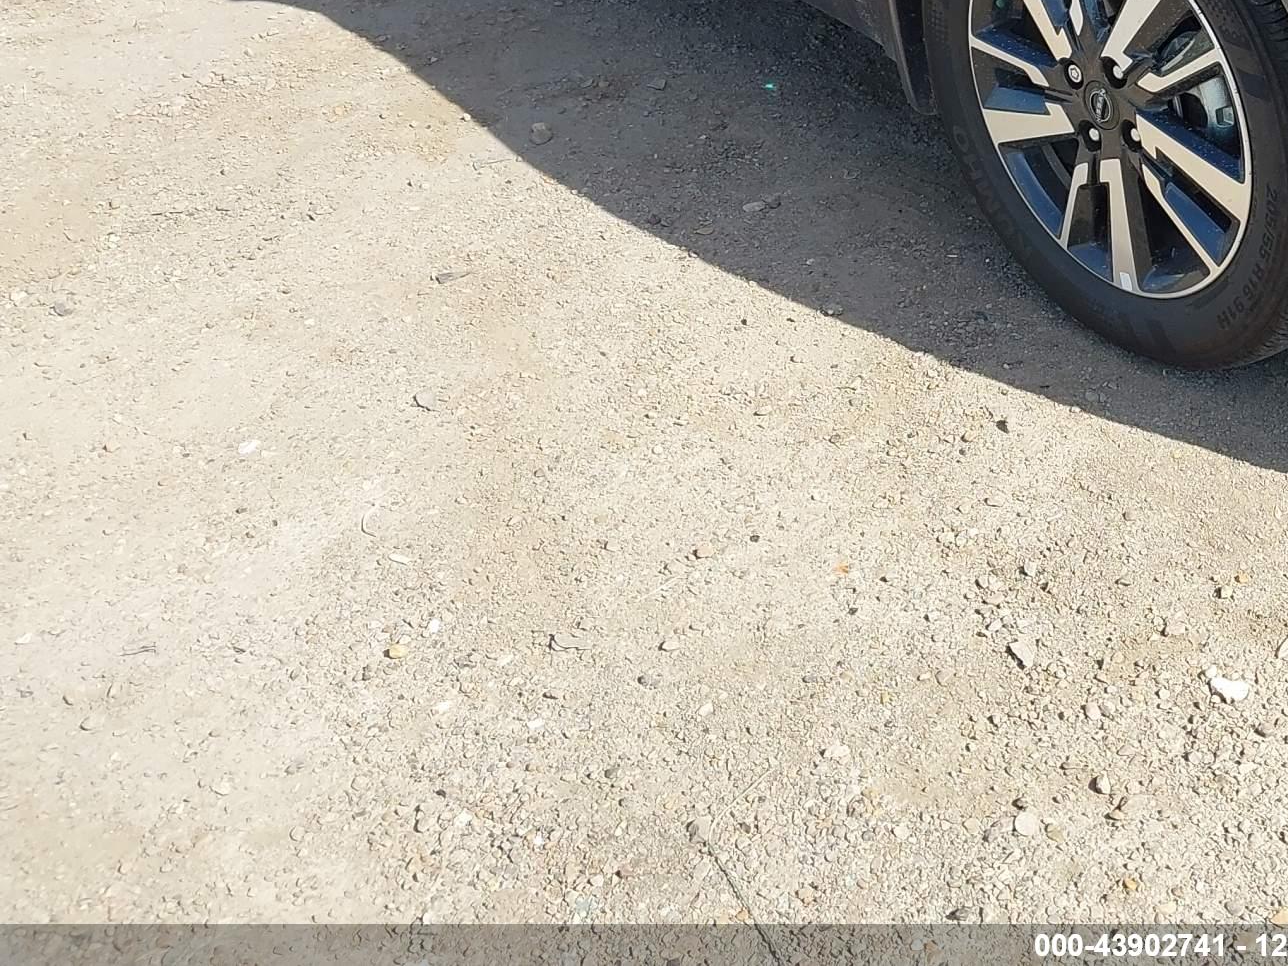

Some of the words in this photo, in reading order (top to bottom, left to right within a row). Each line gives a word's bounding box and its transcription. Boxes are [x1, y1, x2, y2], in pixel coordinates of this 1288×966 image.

[1260, 185, 1278, 261] 205/55
[1242, 262, 1266, 301] R16
[1215, 295, 1246, 331] 91H
